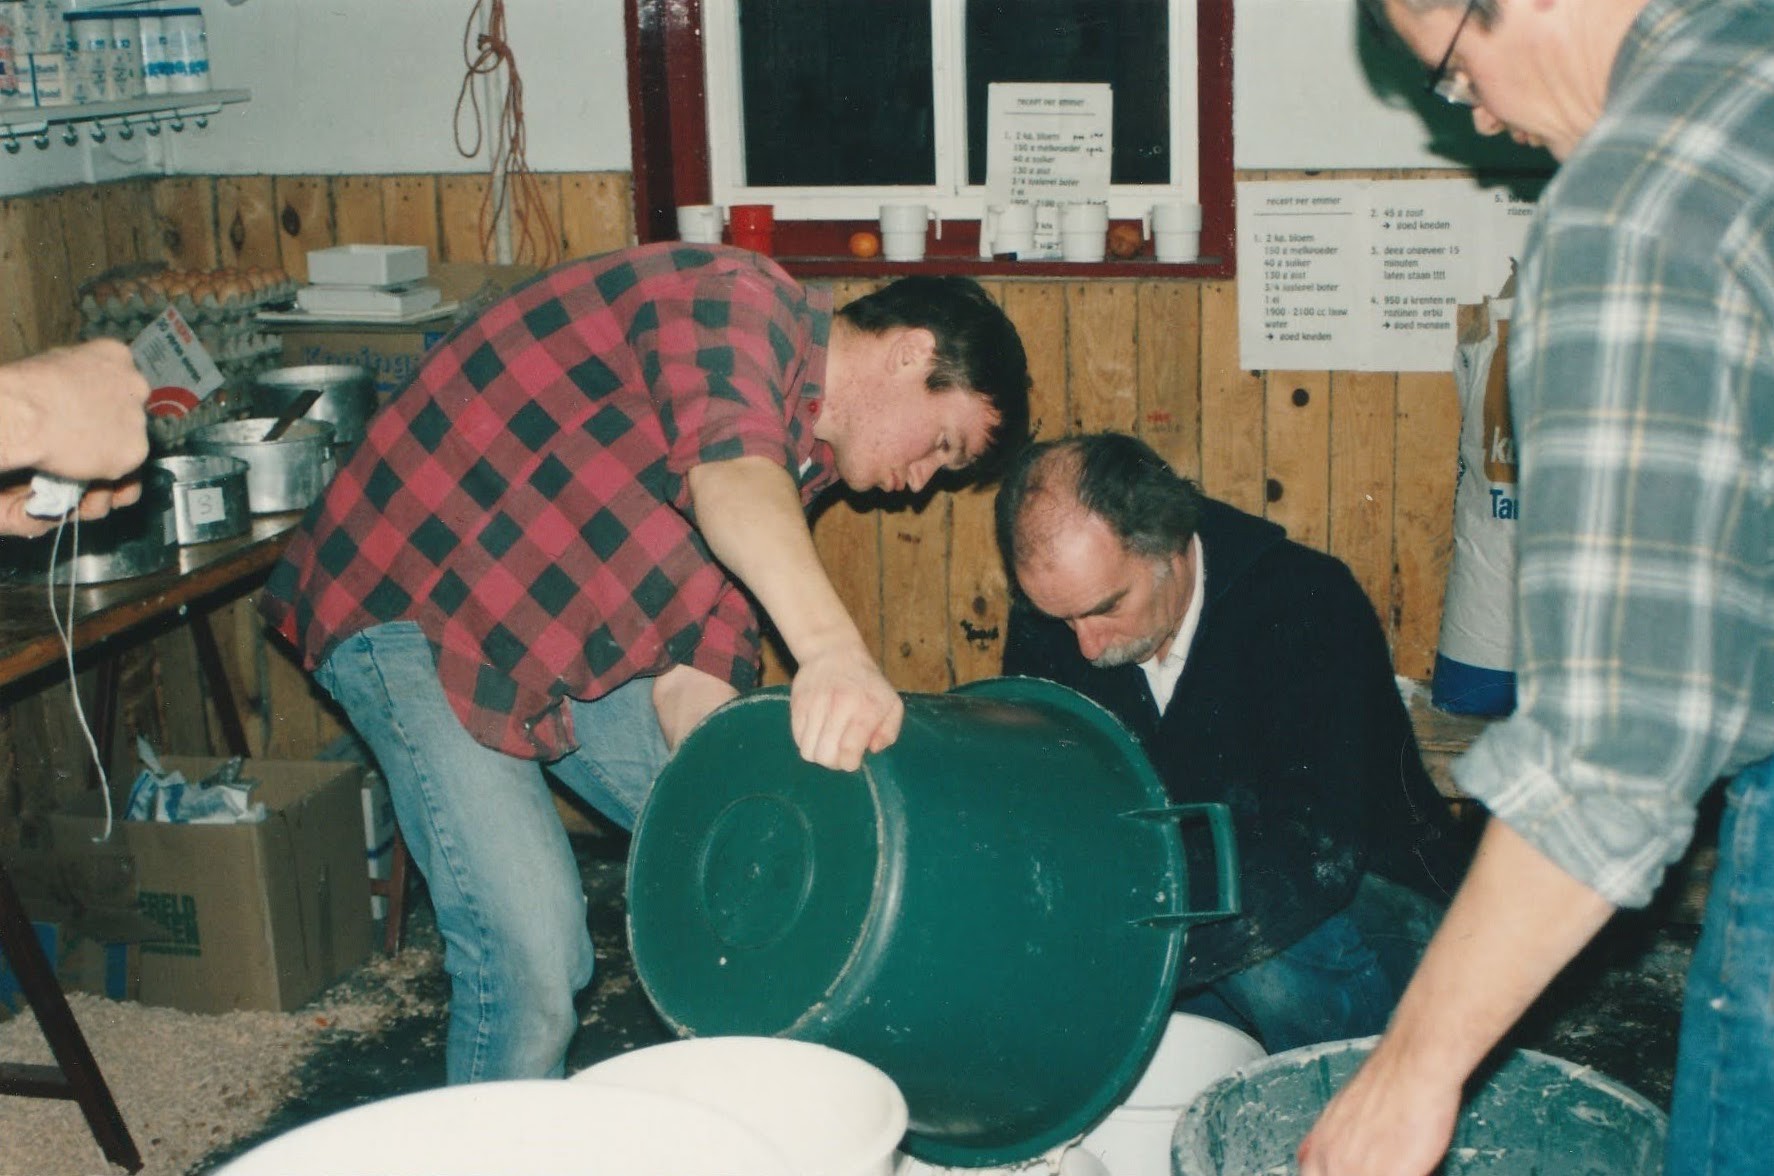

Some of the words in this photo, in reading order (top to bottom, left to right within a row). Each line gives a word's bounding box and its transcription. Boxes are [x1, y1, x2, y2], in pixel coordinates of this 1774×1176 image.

[1420, 221, 1450, 230] kneden
[1266, 234, 1271, 243] 2
[1289, 234, 1314, 242] bloem
[1449, 246, 1460, 254] 15
[1264, 258, 1275, 267] 40
[1285, 258, 1311, 267] suiker
[1384, 258, 1418, 267] minuten
[1384, 271, 1405, 280] laten
[1408, 271, 1431, 280] staan
[1316, 283, 1339, 291] boter
[1272, 296, 1280, 304] ei
[1410, 296, 1443, 304] krenten
[1265, 307, 1286, 316] 1900
[1293, 307, 1315, 316] 2100
[1265, 320, 1288, 328] water
[1302, 332, 1332, 341] kneden
